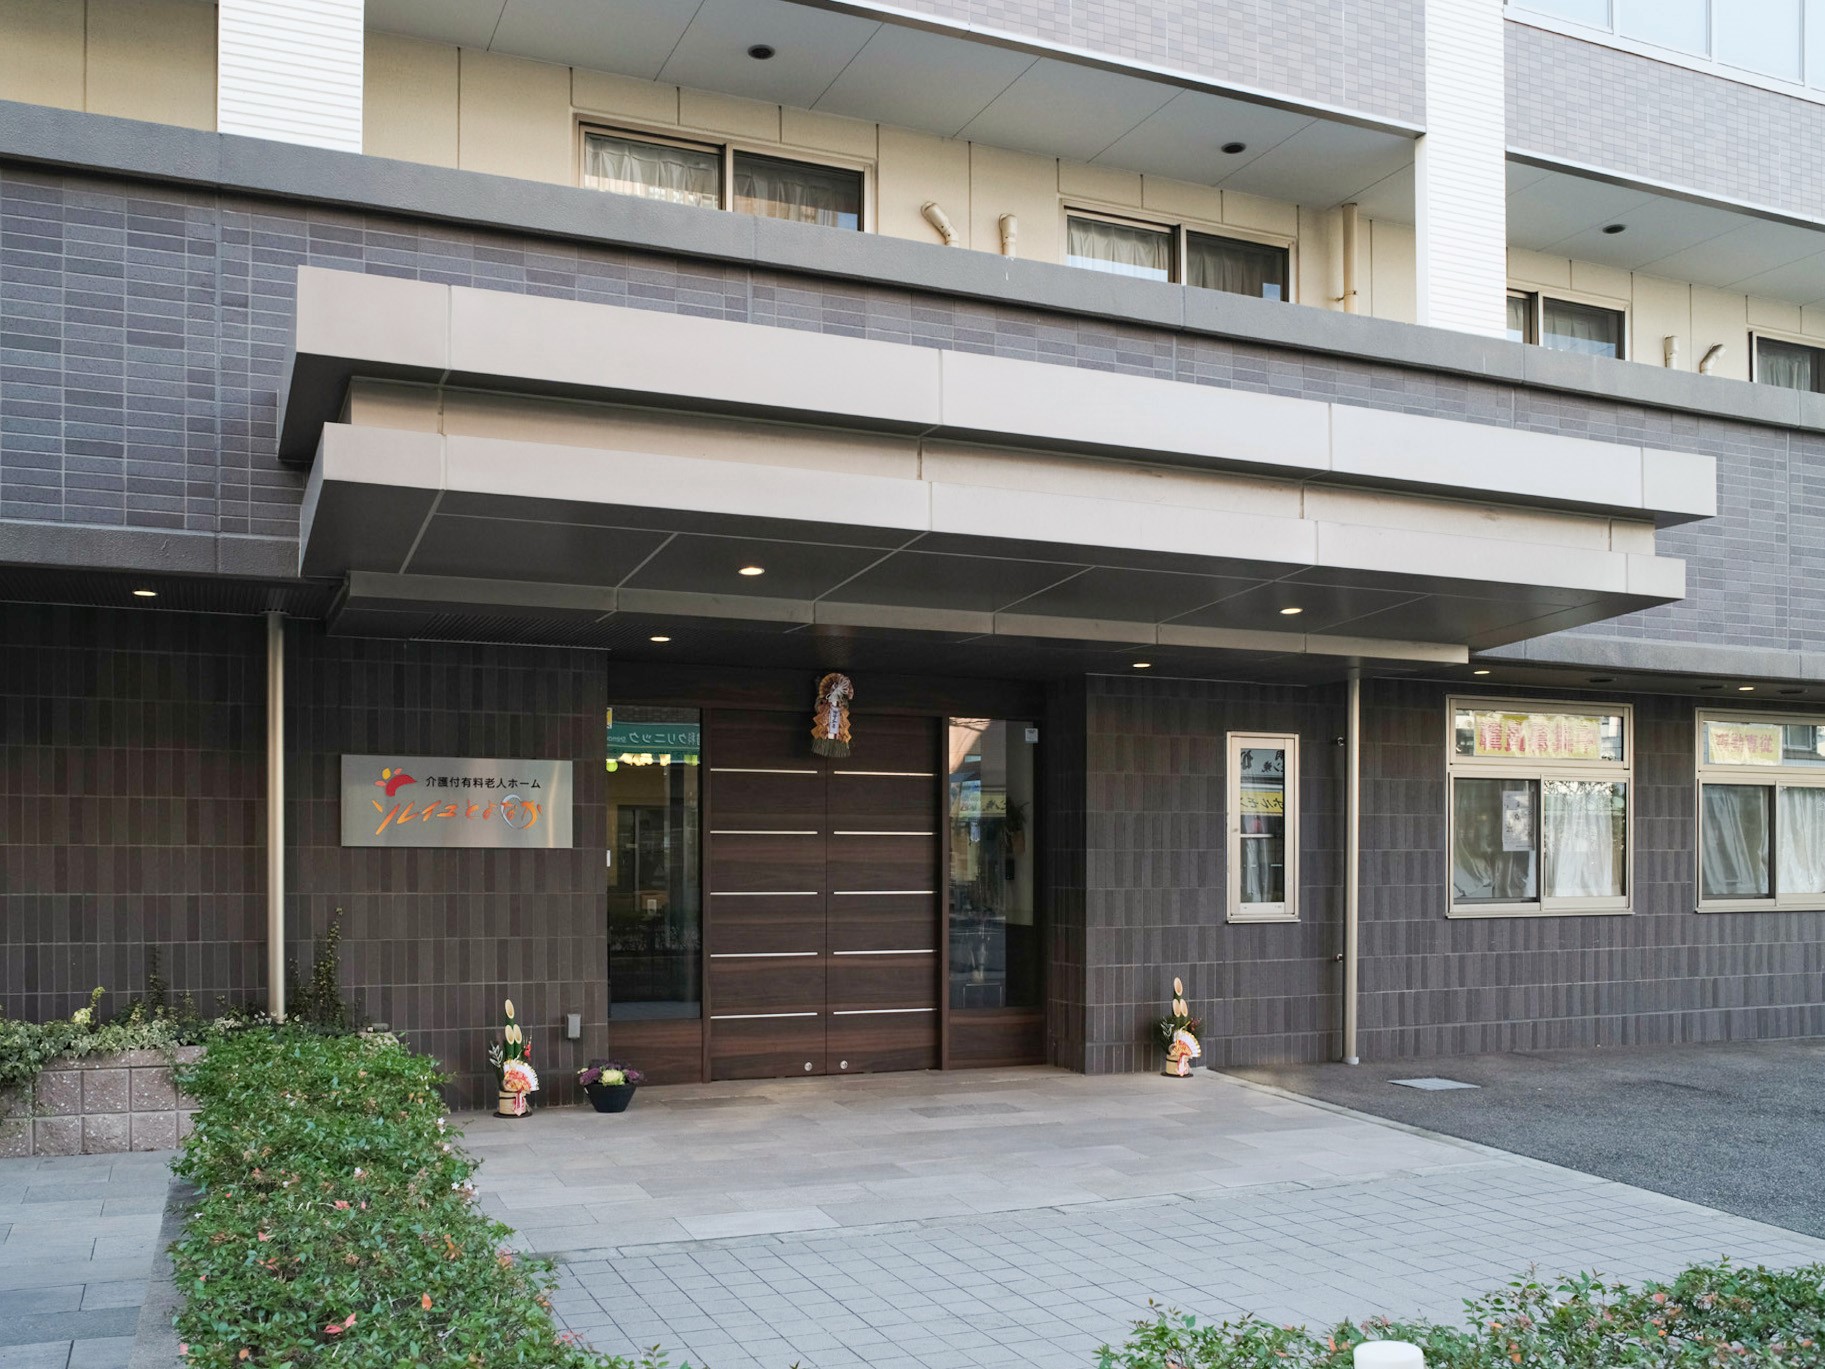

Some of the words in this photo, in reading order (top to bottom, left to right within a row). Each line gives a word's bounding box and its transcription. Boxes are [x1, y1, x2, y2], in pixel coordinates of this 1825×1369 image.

[425, 776, 541, 789] 介護付有料老人ホーム
[371, 795, 543, 836] ソレイユとよなか
